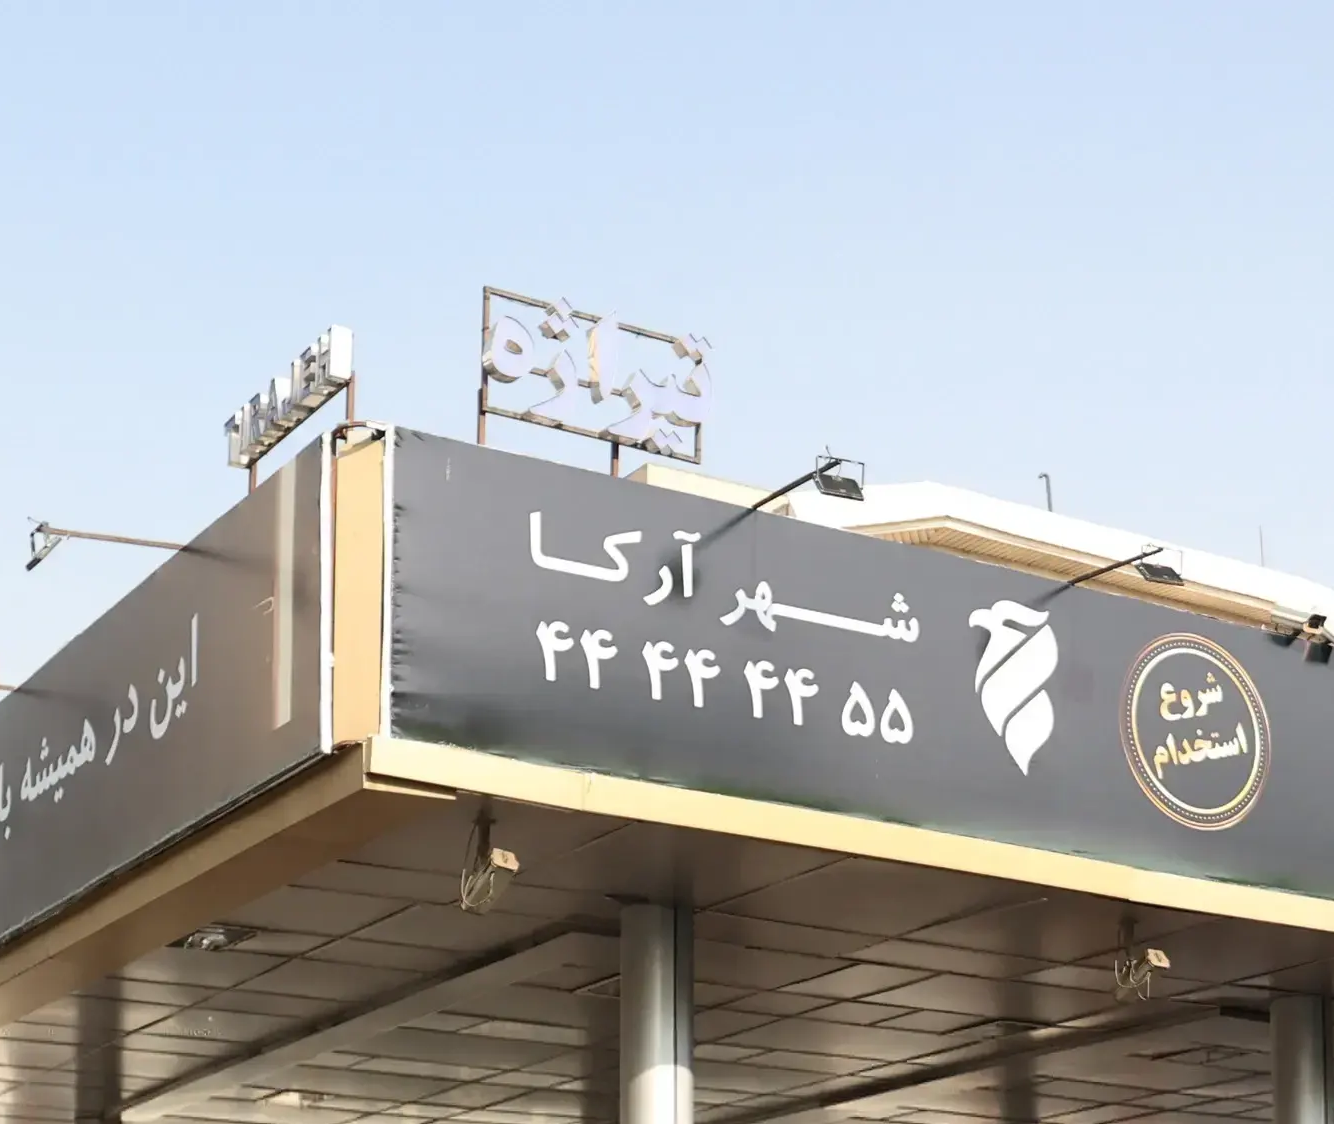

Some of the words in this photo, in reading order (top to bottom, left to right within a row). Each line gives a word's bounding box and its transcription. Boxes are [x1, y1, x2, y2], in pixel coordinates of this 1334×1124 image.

[482, 297, 712, 454] تیراژه
[530, 511, 701, 605] آرکا
[719, 581, 919, 643] شهر
[150, 613, 198, 739] این
[536, 620, 618, 689] ۴۴
[642, 641, 720, 708] ۴۴
[744, 661, 818, 725] ۴۴
[841, 681, 914, 744] ۵۵
[1160, 671, 1223, 721] شروع
[21, 719, 96, 803] همیشه
[105, 684, 138, 765] در
[1154, 722, 1248, 779] استخدام
